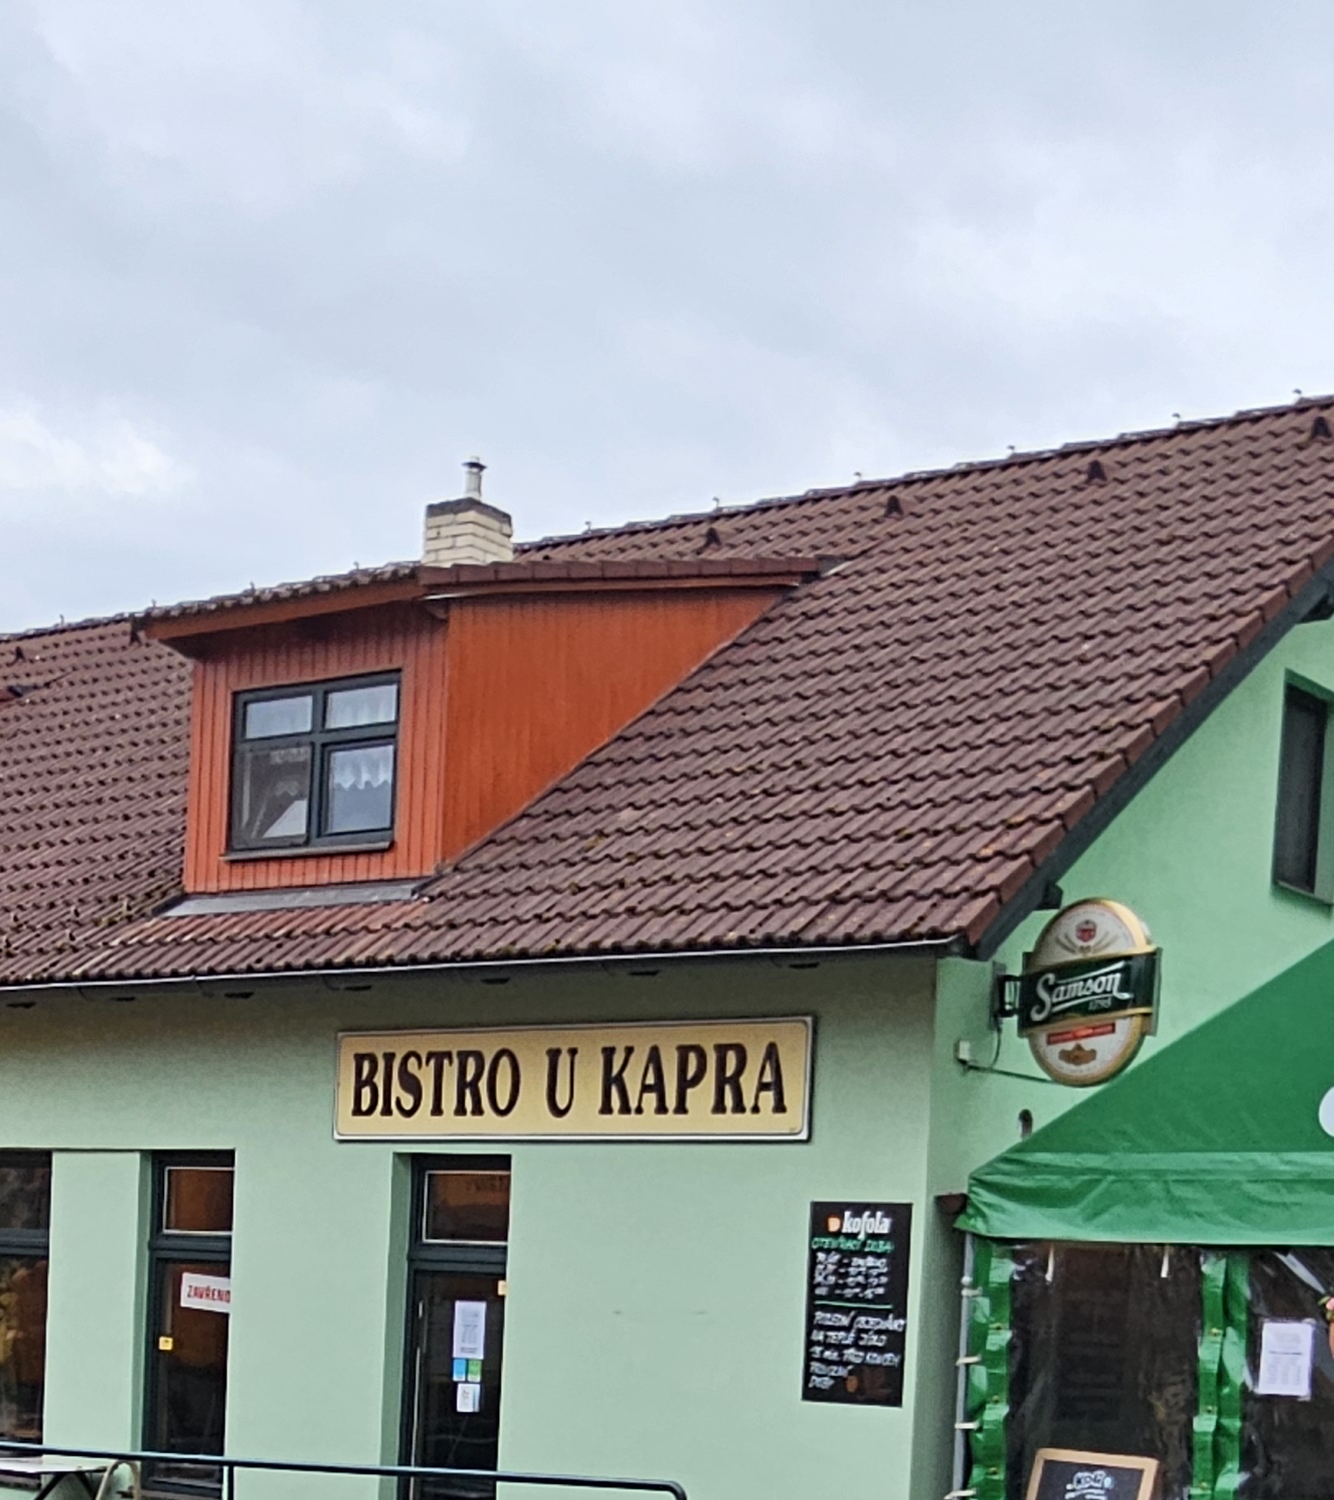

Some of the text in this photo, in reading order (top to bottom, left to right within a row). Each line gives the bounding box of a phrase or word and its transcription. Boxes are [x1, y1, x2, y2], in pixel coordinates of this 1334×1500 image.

[1030, 971, 1135, 1022] Samson
[351, 1041, 788, 1118] BISTRO U KAPRA
[841, 1210, 892, 1241] kofola
